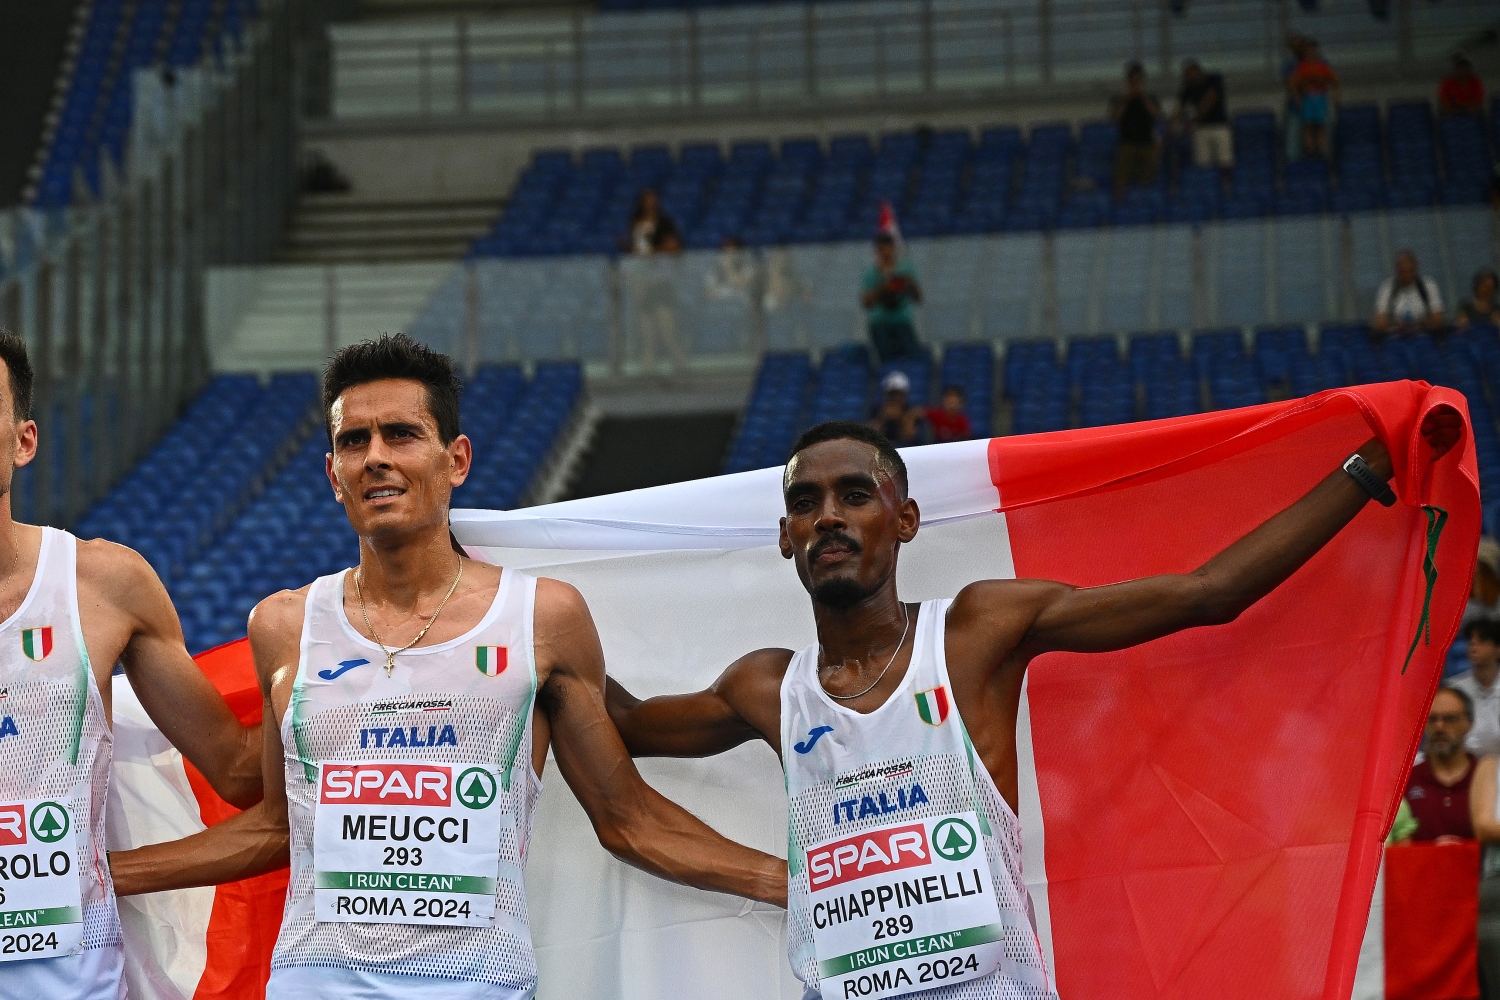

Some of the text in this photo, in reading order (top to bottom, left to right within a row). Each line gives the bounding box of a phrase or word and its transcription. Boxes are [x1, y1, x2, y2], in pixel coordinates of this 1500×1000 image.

[372, 700, 453, 711] FRECCIAROSSA
[359, 724, 458, 749] ITALIA
[325, 769, 448, 801] SPAR
[835, 761, 913, 785] FRECCIAROSSA
[833, 784, 930, 825] ITALIA
[342, 815, 469, 844] MEUCCI
[382, 847, 423, 866] 293
[810, 831, 926, 885] SPAR
[349, 875, 353, 887] I
[357, 874, 392, 888] RUN
[336, 896, 471, 919] ROMA 2024
[813, 868, 983, 929] CHIAPPINELLI
[872, 914, 914, 940] 289
[2, 931, 59, 954] 2024
[849, 955, 855, 969] I
[856, 946, 890, 968] RUN
[843, 953, 980, 1000] ROMA 2024
